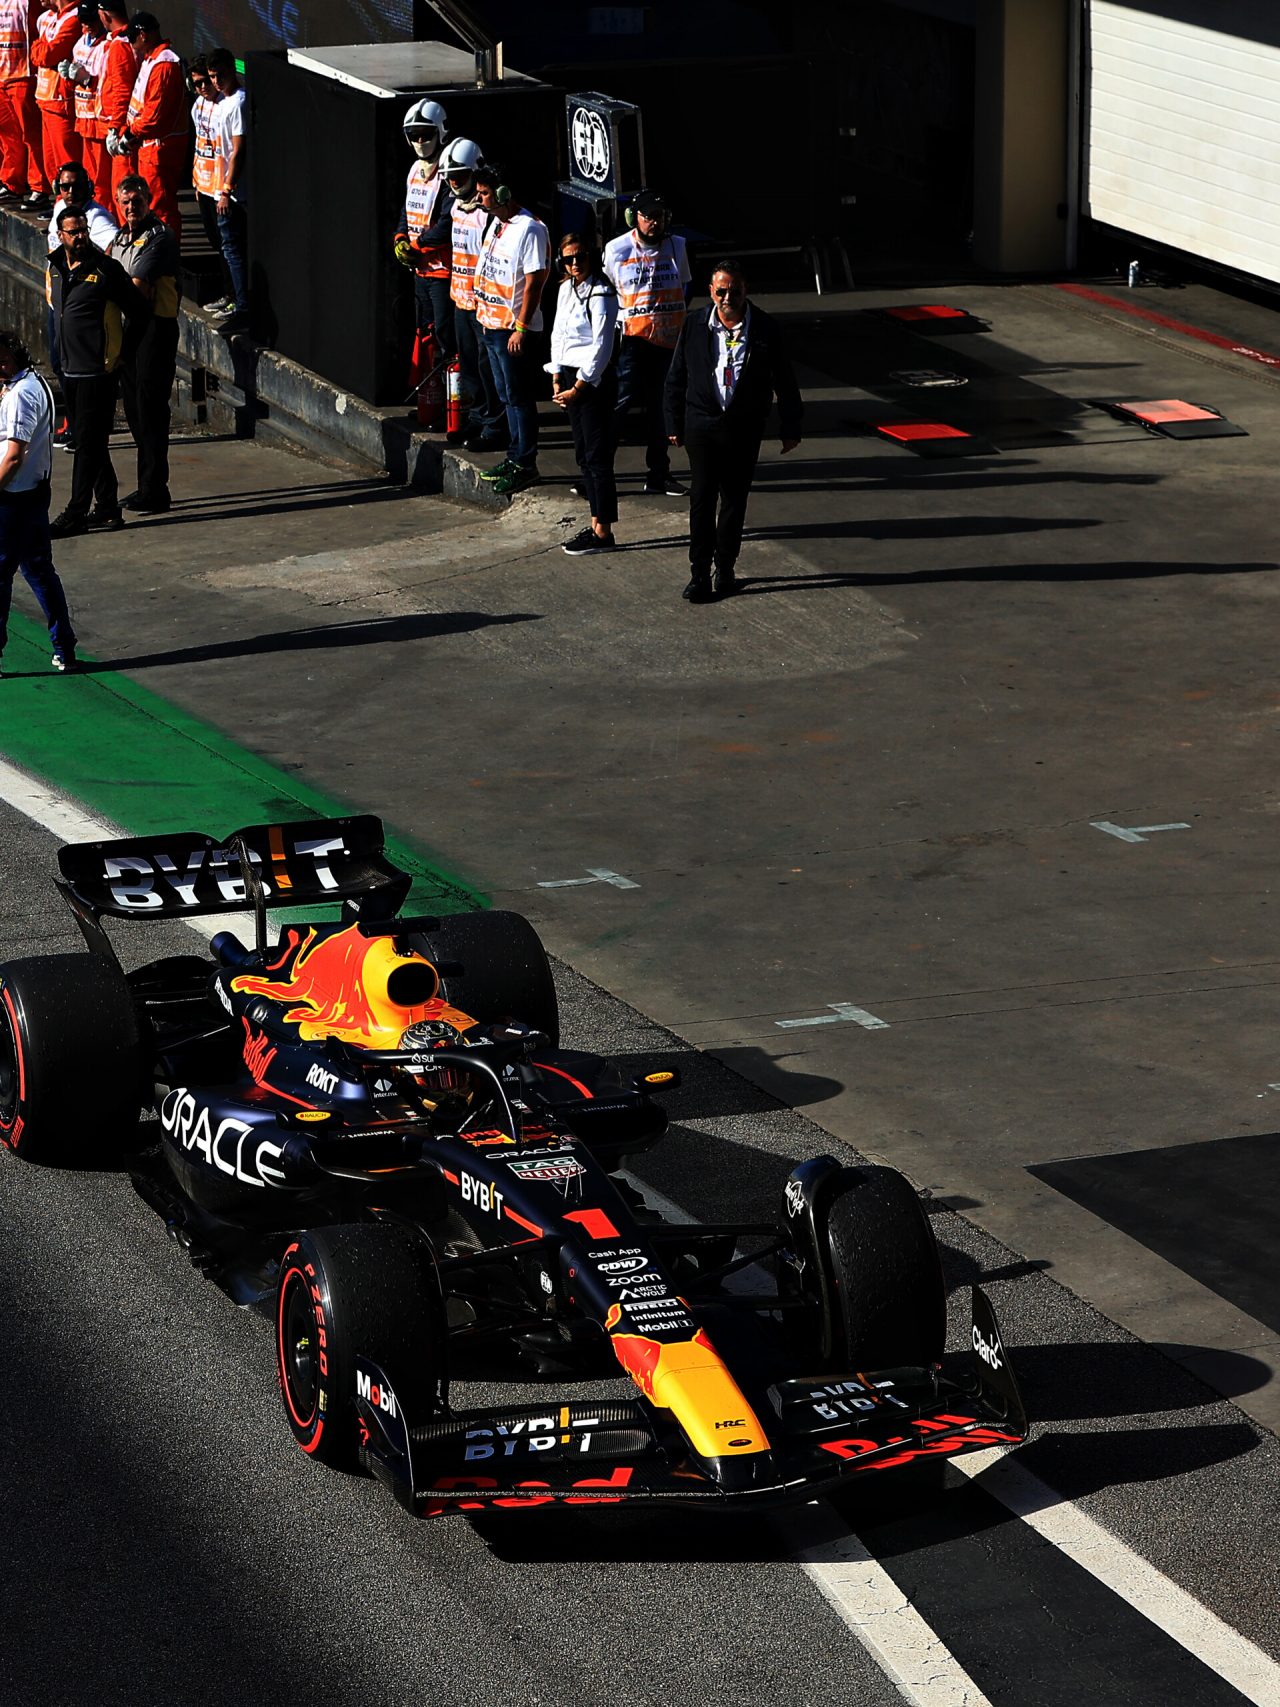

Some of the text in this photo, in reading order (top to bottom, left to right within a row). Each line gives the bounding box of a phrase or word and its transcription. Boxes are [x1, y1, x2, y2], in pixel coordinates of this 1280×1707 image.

[574, 119, 608, 169] FIA
[103, 826, 346, 908] BYBIT
[421, 1054, 435, 1063] Sui
[304, 1062, 339, 1095] ROKT
[161, 1087, 287, 1188] ORACLE
[485, 1143, 577, 1159] ORACLE
[516, 1157, 575, 1170] TAG
[520, 1165, 582, 1178] HEUER
[461, 1170, 504, 1221] BYBIT
[561, 1208, 621, 1240] 1
[588, 1247, 642, 1259] Cash App
[597, 1259, 638, 1272] CDW
[606, 1273, 662, 1287] zoom
[634, 1284, 668, 1292] ARCTIC
[639, 1289, 667, 1298] WOLF
[623, 1298, 679, 1312] PIRELLI
[630, 1309, 686, 1321] infinitum
[311, 1284, 329, 1377] ZERO
[638, 1321, 679, 1333] Mobil
[972, 1325, 1003, 1370] Claro
[356, 1369, 397, 1419] Mobil
[715, 1418, 747, 1430] HRC
